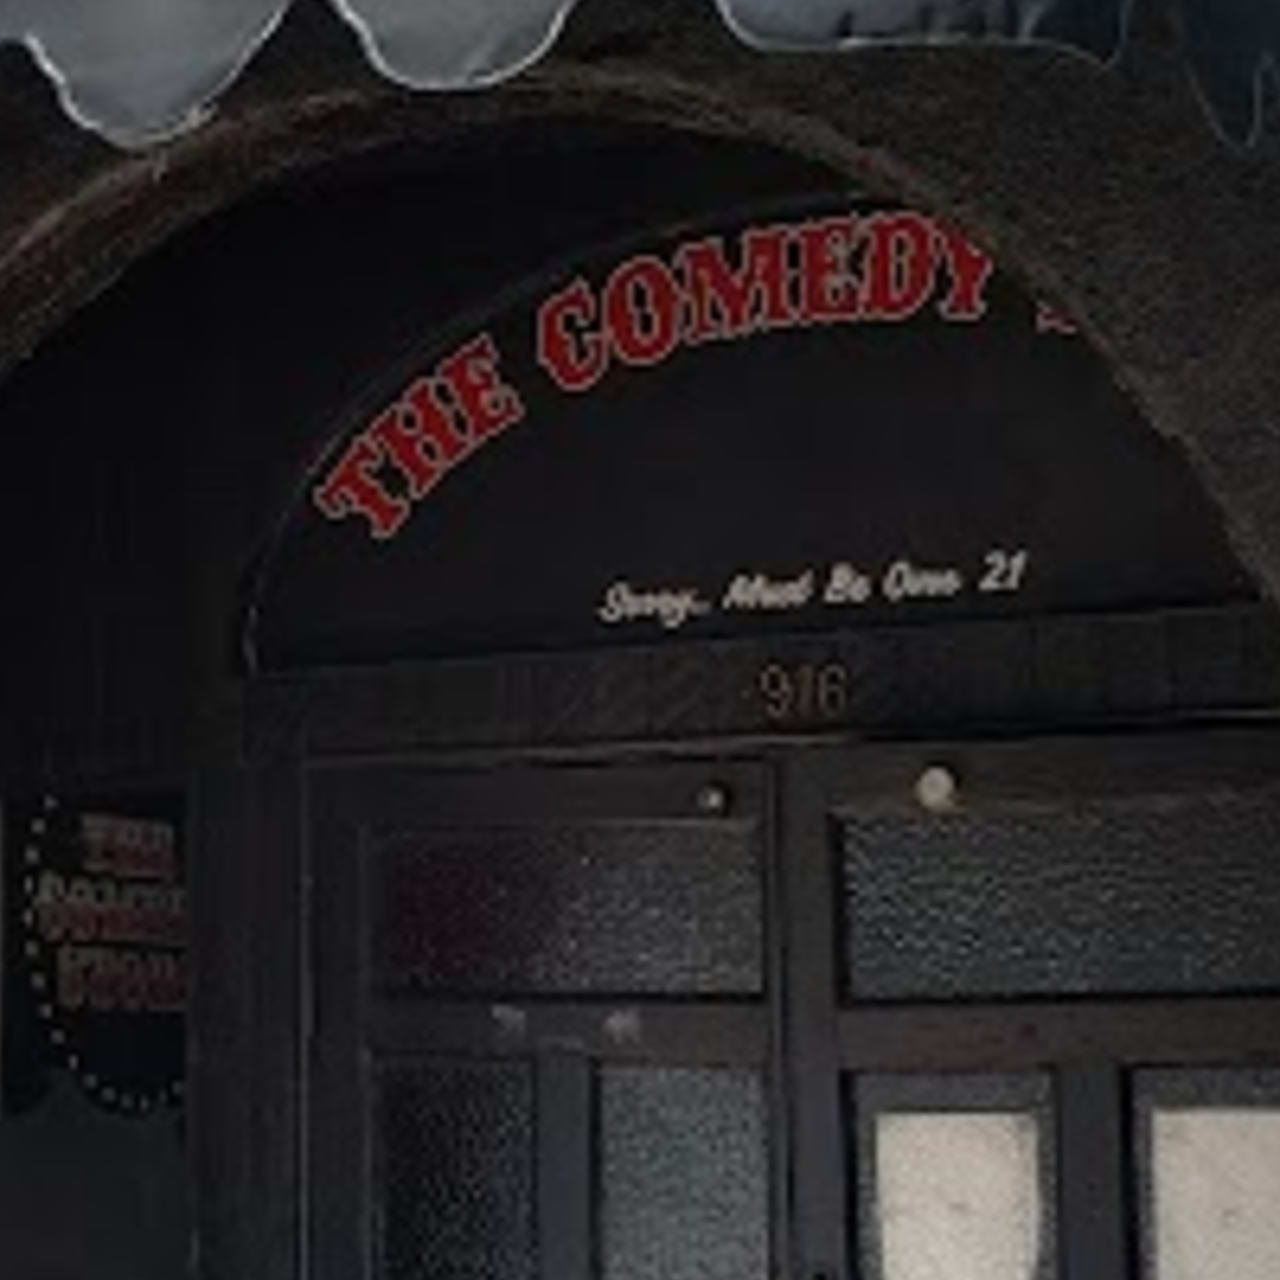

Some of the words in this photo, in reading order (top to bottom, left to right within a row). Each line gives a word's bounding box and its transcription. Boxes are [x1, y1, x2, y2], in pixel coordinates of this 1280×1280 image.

[315, 338, 524, 538] THE
[537, 211, 992, 391] COMEDY
[979, 551, 1026, 591] 21
[759, 664, 849, 719] 916
